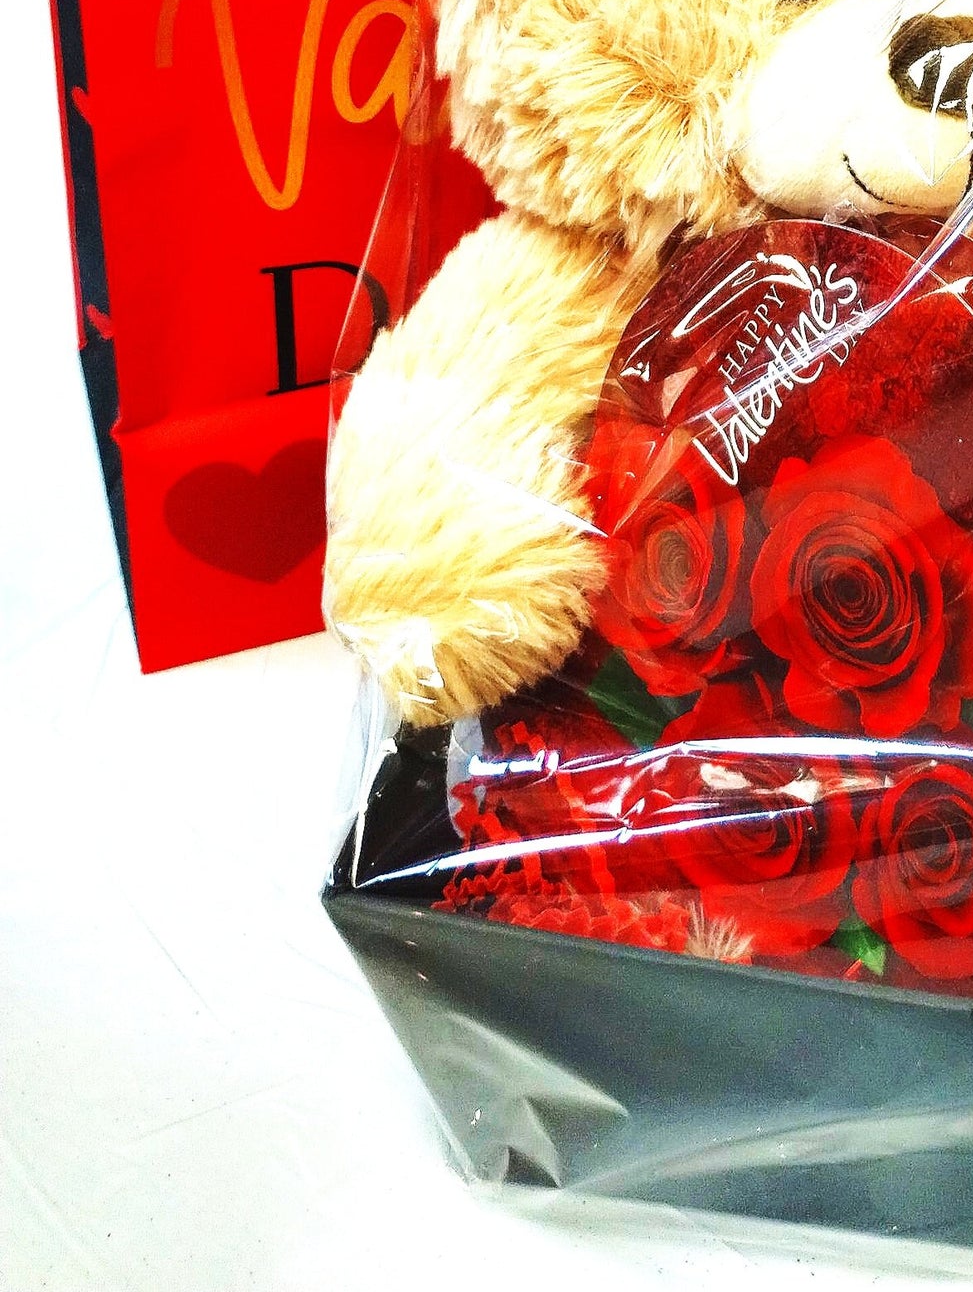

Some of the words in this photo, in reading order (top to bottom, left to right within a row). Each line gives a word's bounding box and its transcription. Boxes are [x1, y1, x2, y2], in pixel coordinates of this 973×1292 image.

[691, 263, 858, 486] Valentine's
[718, 284, 786, 384] HAPPY
[828, 299, 872, 367] DAY
